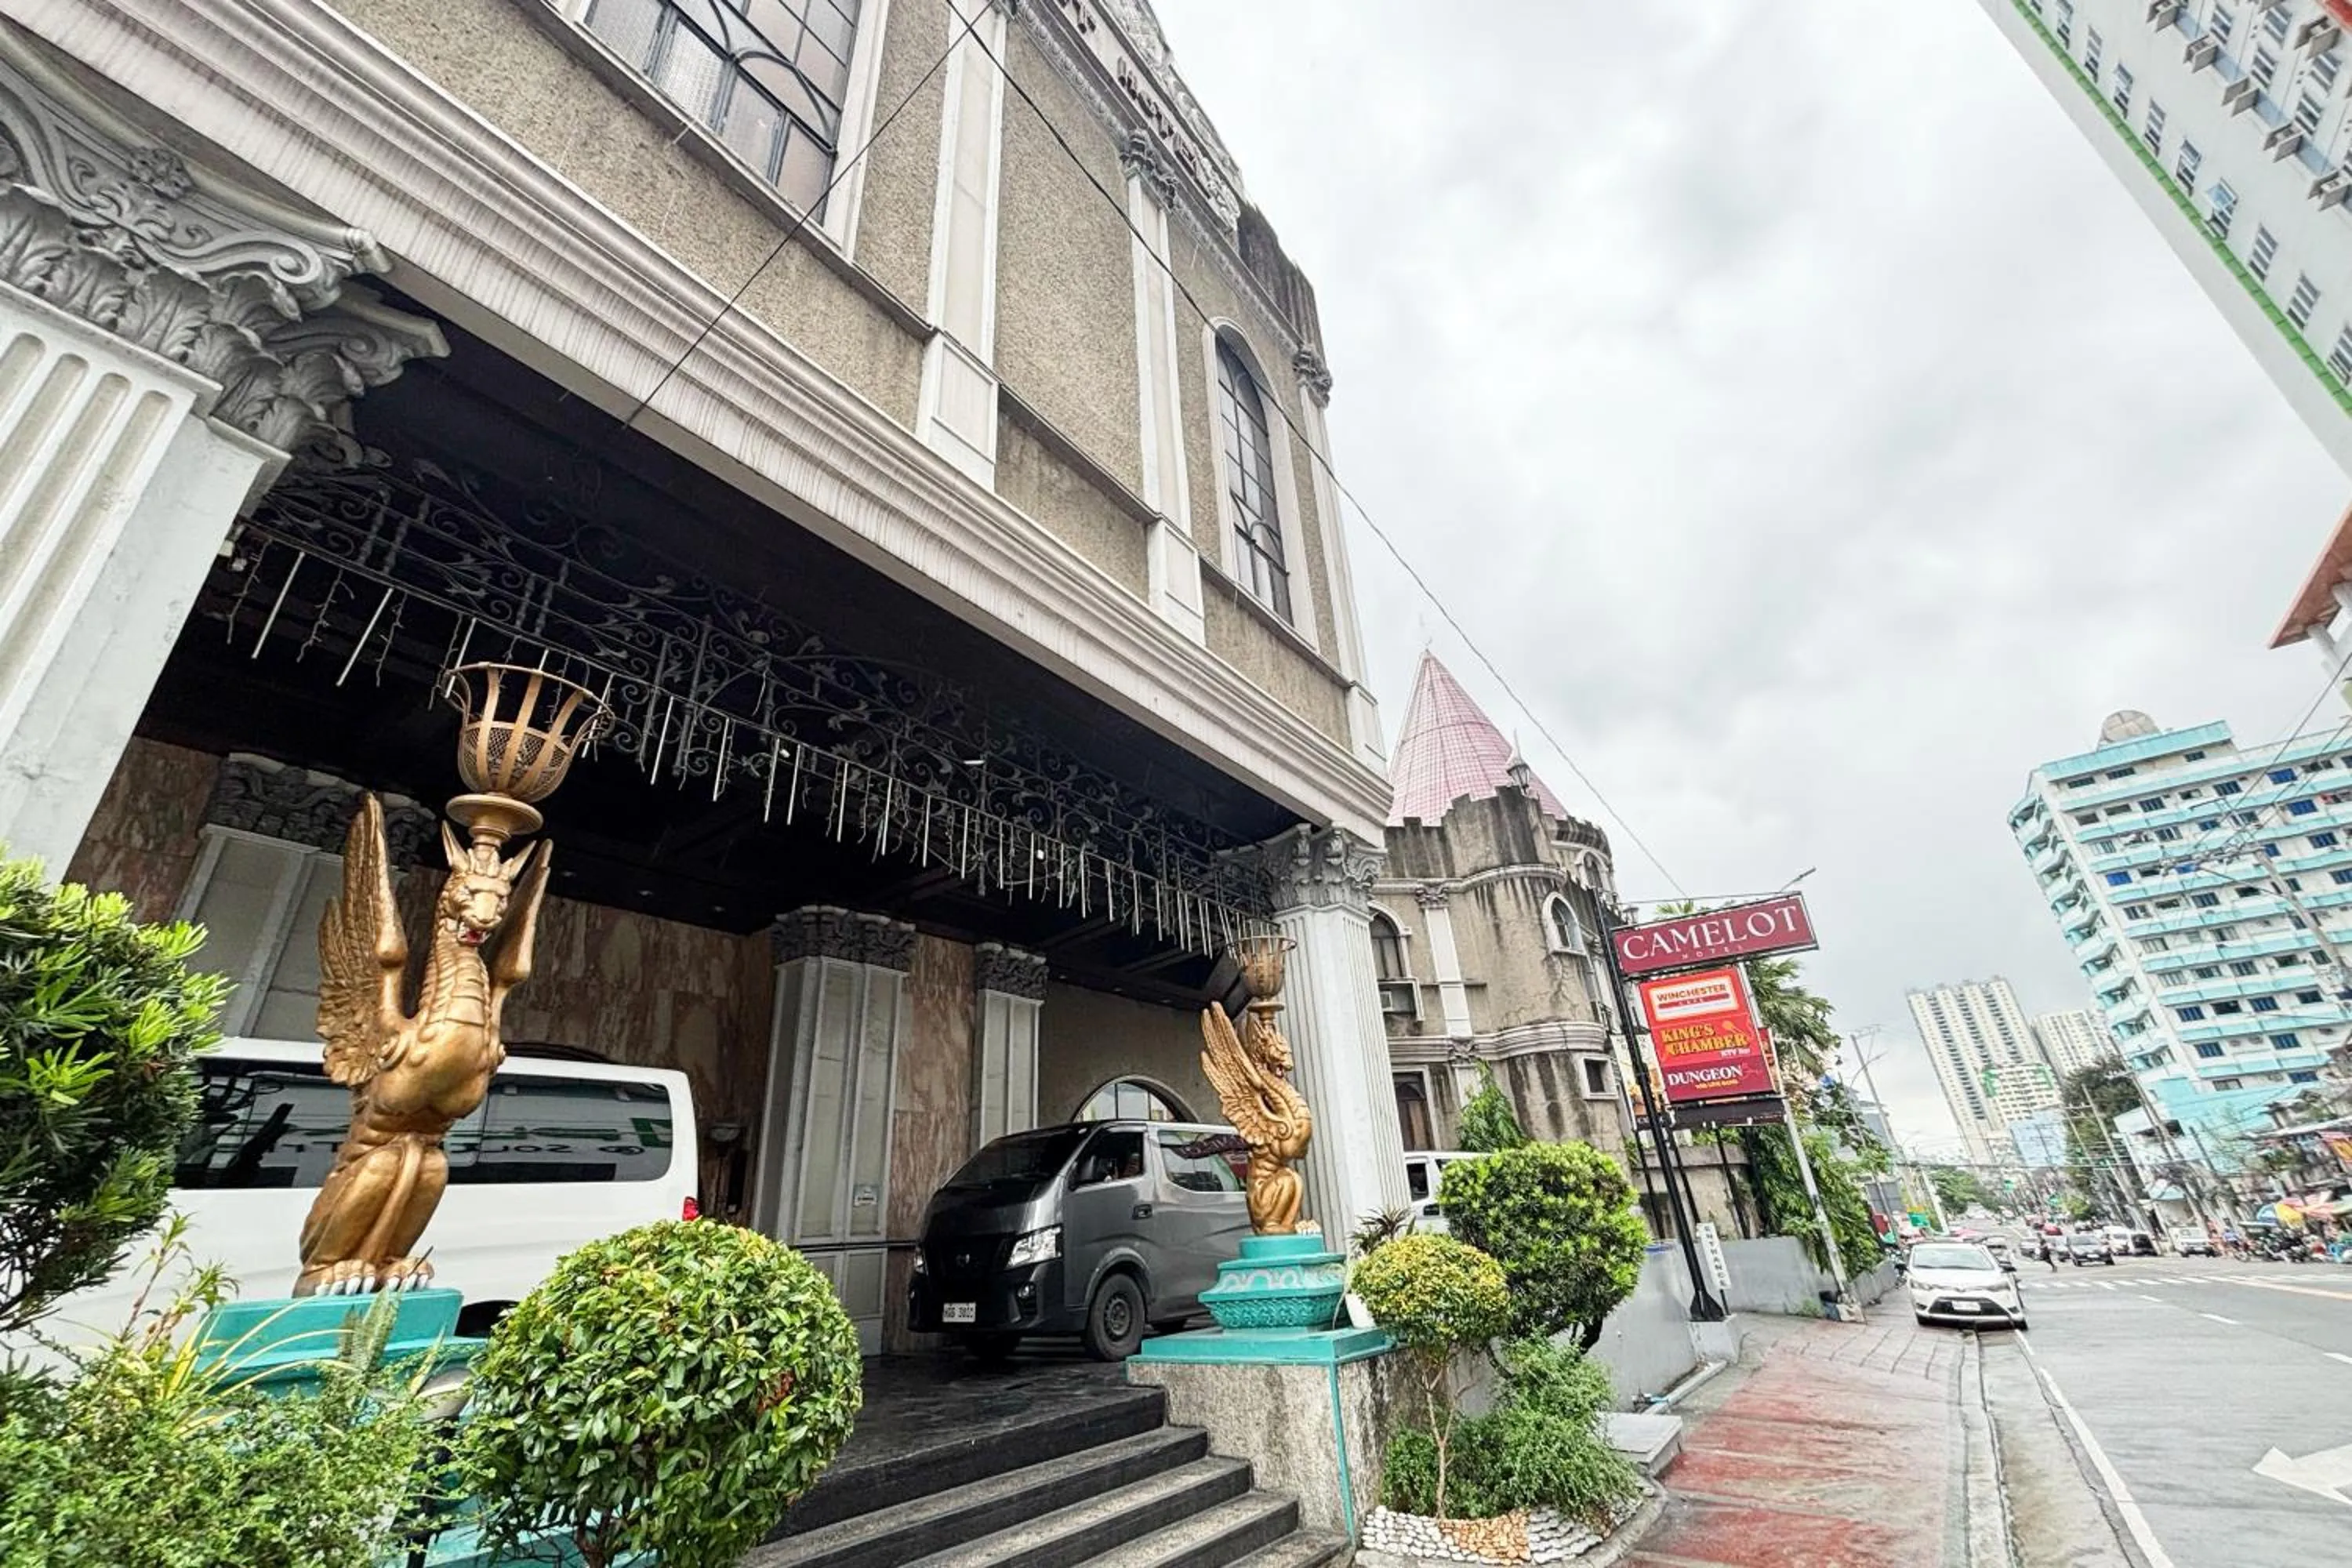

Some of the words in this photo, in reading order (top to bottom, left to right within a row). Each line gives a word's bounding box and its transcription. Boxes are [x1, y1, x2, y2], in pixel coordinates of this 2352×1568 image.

[1623, 906, 1797, 960] CAMELOT
[1681, 946, 1744, 960] HOTEL
[1657, 984, 1727, 1002] WINCHESTER
[1660, 1023, 1715, 1043] KING'S
[1664, 1033, 1750, 1055] CHAMBER
[1667, 1065, 1743, 1086] DUNGEON
[1704, 1225, 1727, 1287] ENTRANCE
